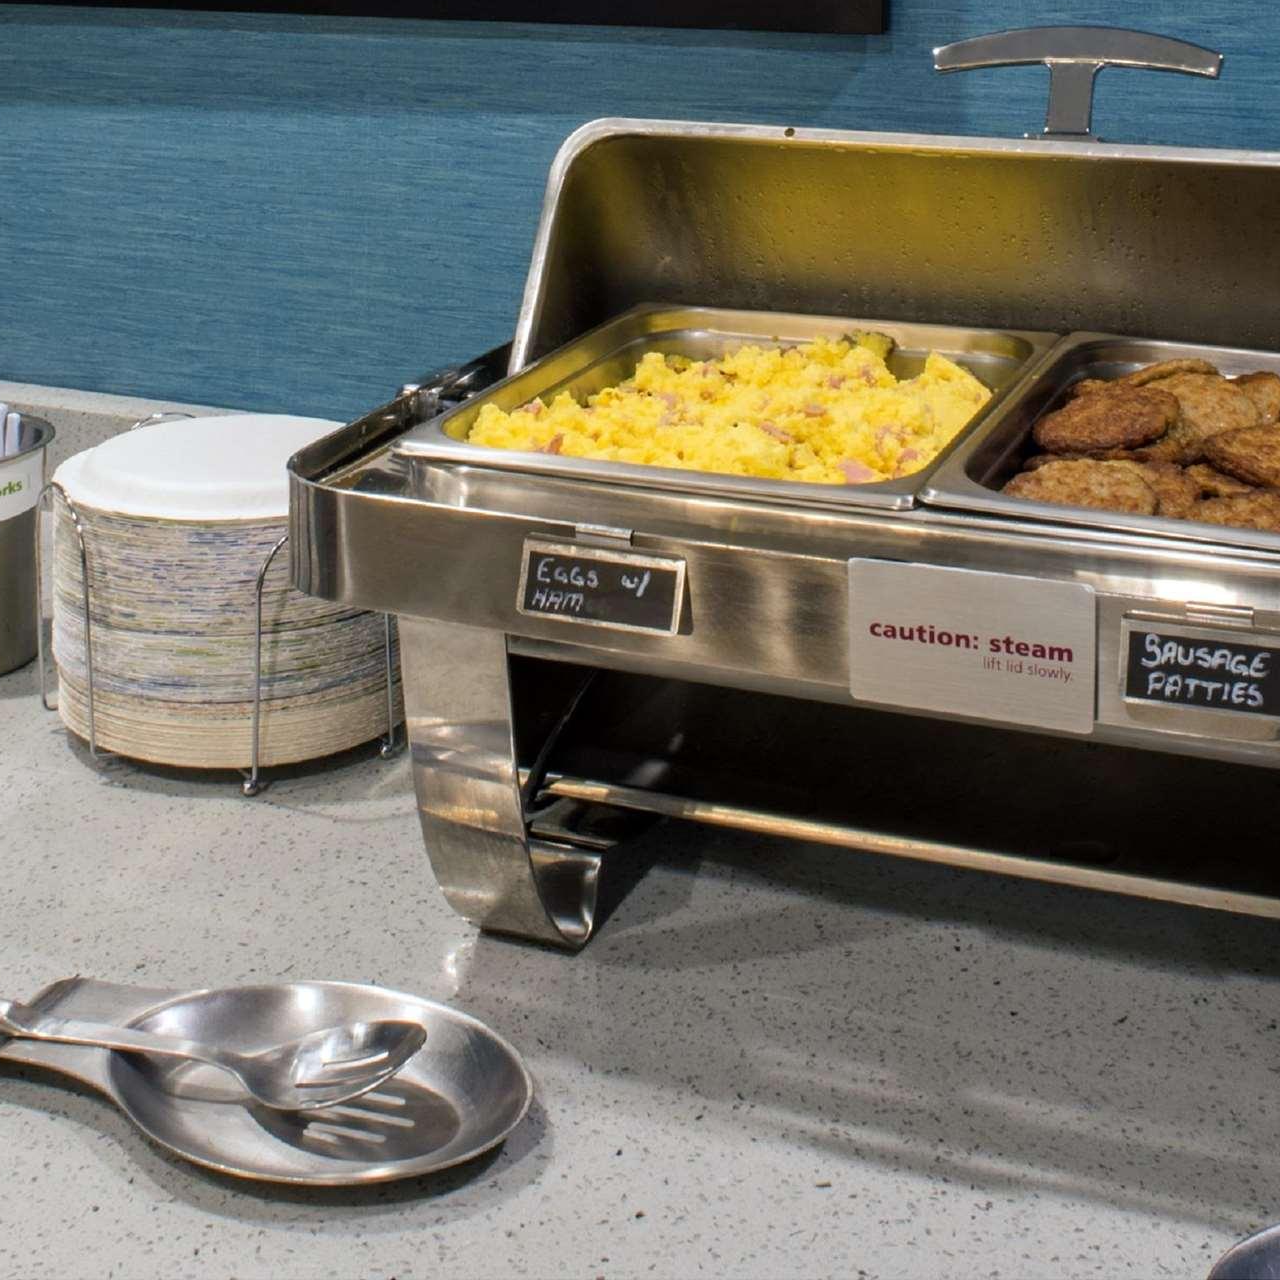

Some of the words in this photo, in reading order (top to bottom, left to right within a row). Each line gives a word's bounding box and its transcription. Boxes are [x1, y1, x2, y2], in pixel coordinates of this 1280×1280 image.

[869, 621, 980, 650] caution:
[988, 635, 1074, 663] steam
[1140, 632, 1271, 678] SAUSAGE
[982, 655, 1001, 672] lift
[1006, 659, 1024, 675] lid
[1027, 663, 1074, 684] slowly.
[1146, 670, 1264, 707] PATTIES
